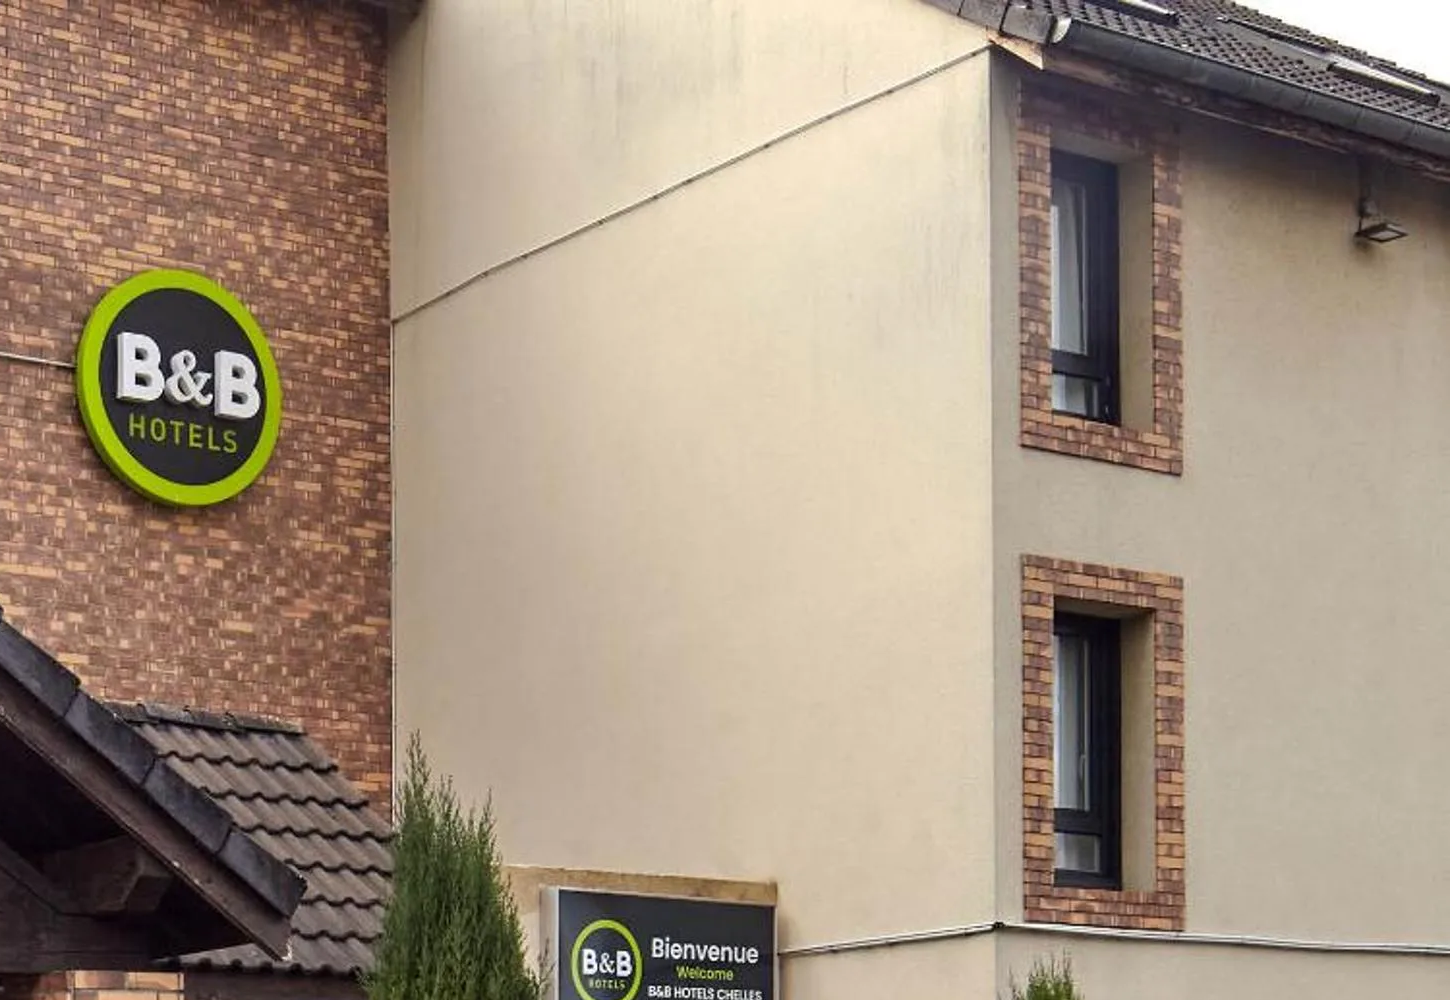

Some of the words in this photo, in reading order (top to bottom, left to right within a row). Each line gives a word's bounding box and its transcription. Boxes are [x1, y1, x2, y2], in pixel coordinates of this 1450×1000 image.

[116, 331, 262, 420] B&B
[128, 412, 238, 453] HOTELS
[582, 948, 633, 977] B&B
[652, 937, 759, 964] Bienvenue
[676, 965, 734, 981] Welcome
[648, 985, 671, 998] B&B
[674, 986, 714, 1000] HOTELS
